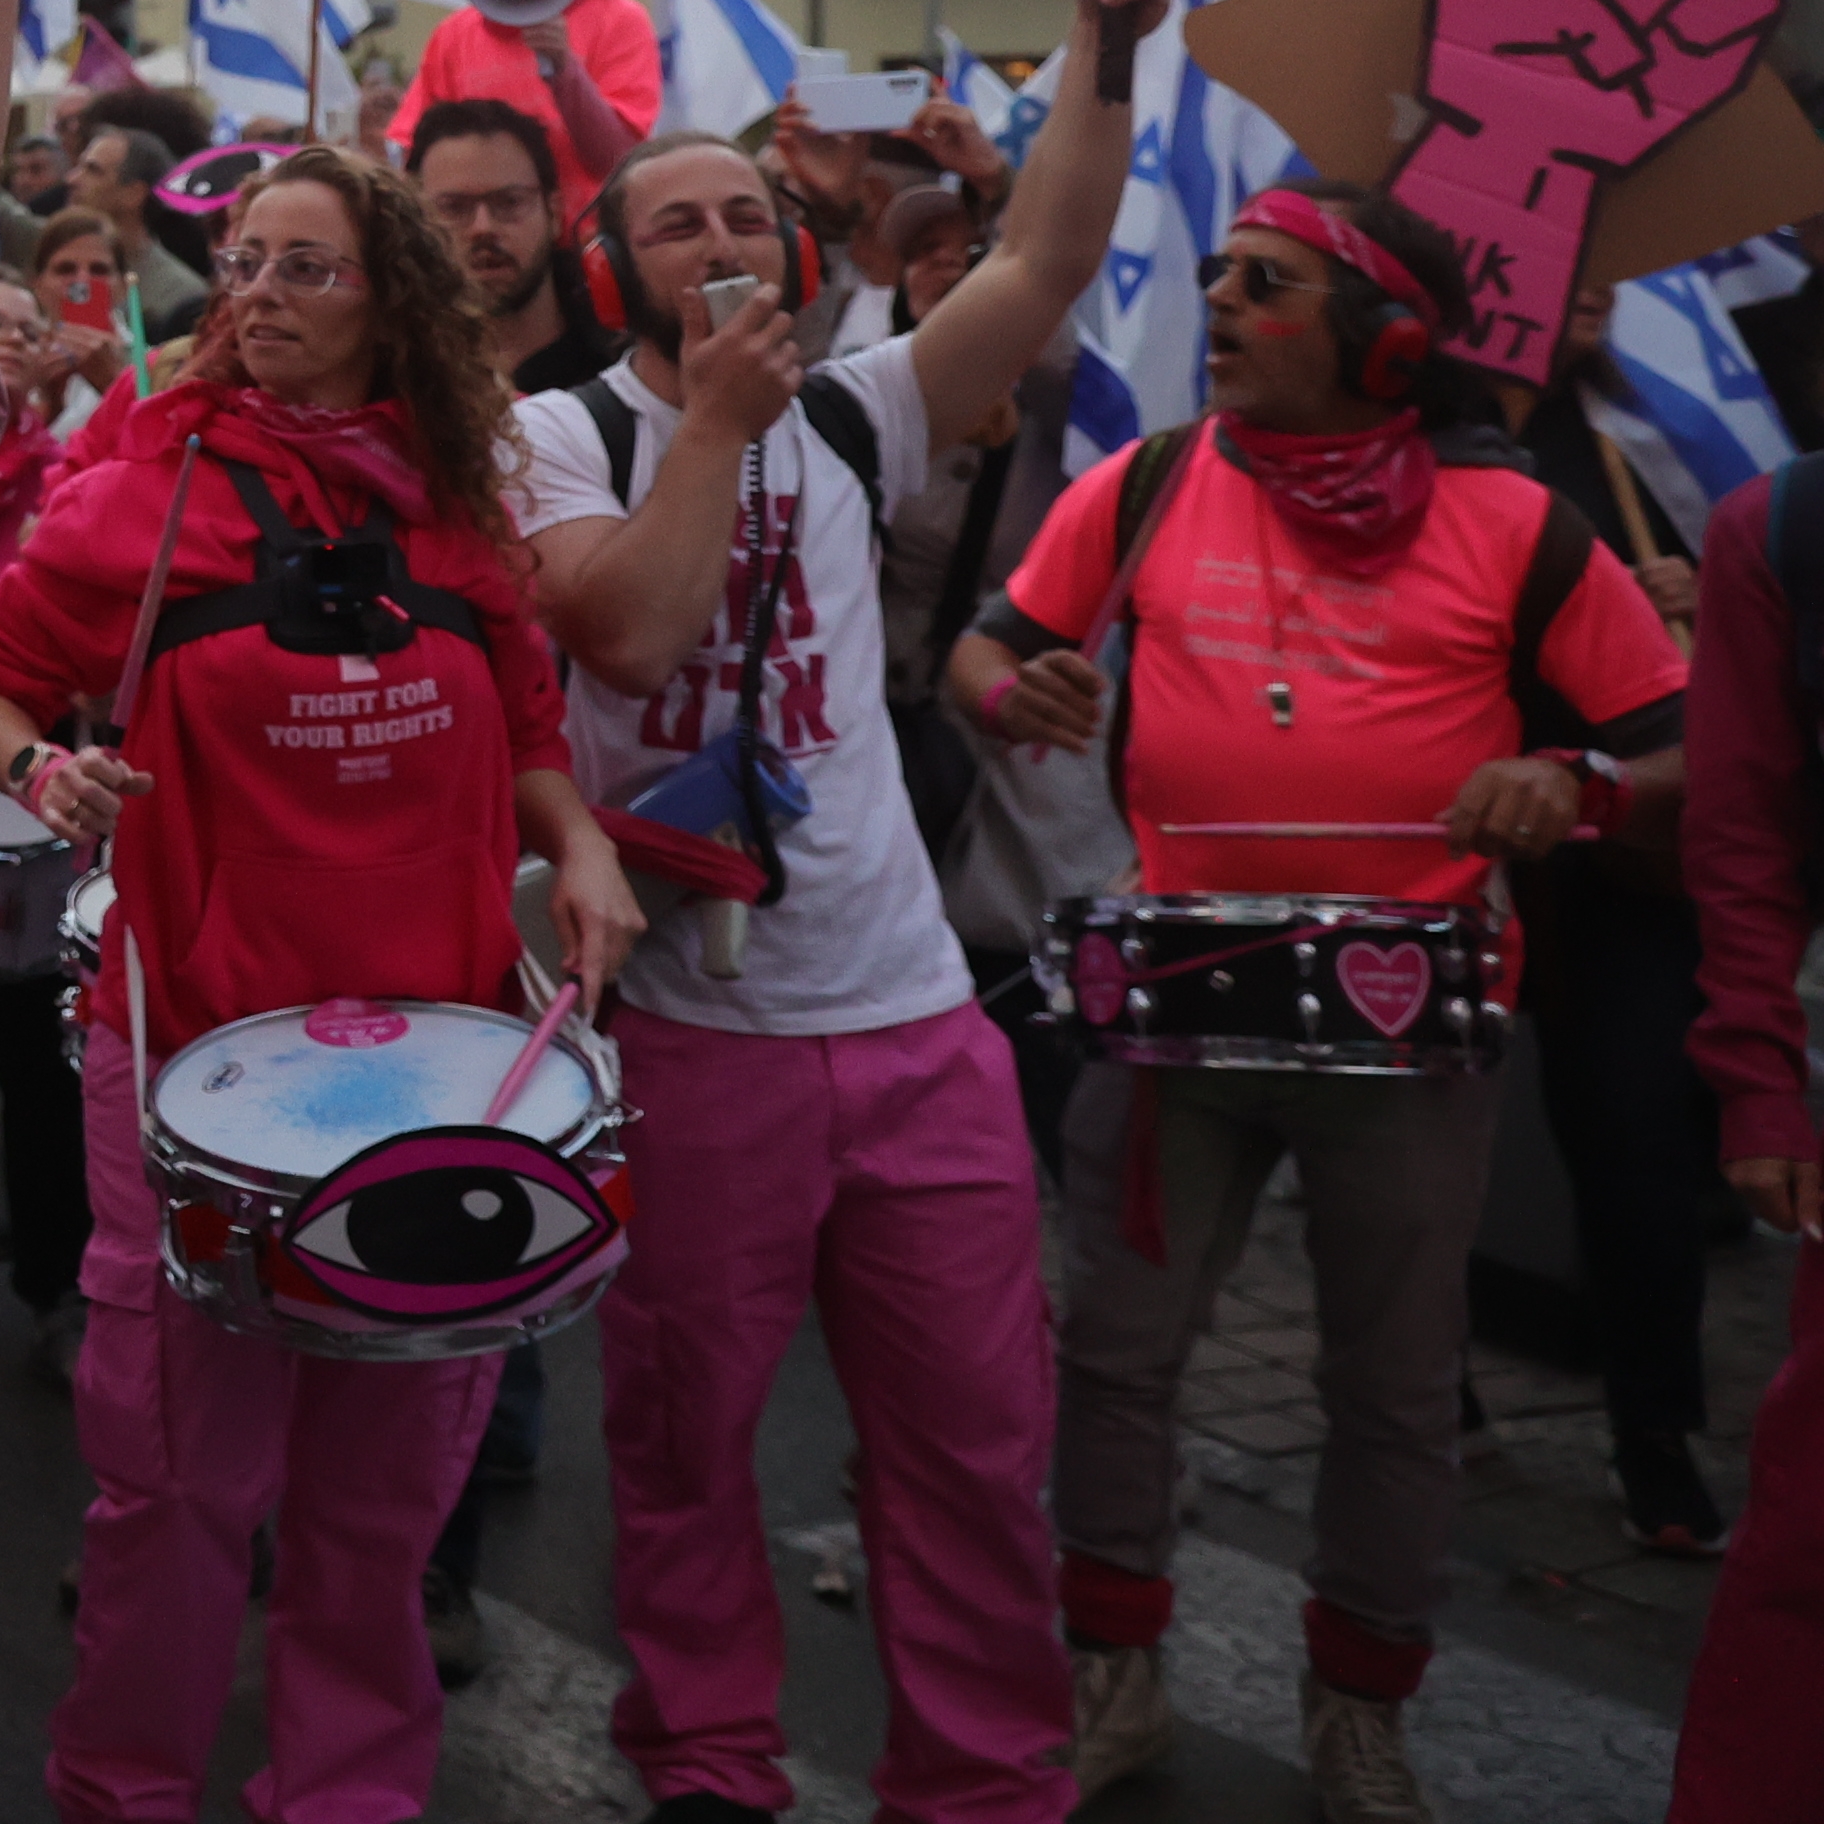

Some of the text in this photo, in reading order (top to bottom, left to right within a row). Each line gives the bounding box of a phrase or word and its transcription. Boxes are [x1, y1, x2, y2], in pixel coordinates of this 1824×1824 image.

[289, 677, 439, 719] FIGHT FOR
[264, 704, 453, 749] YOUR RIGHTS
